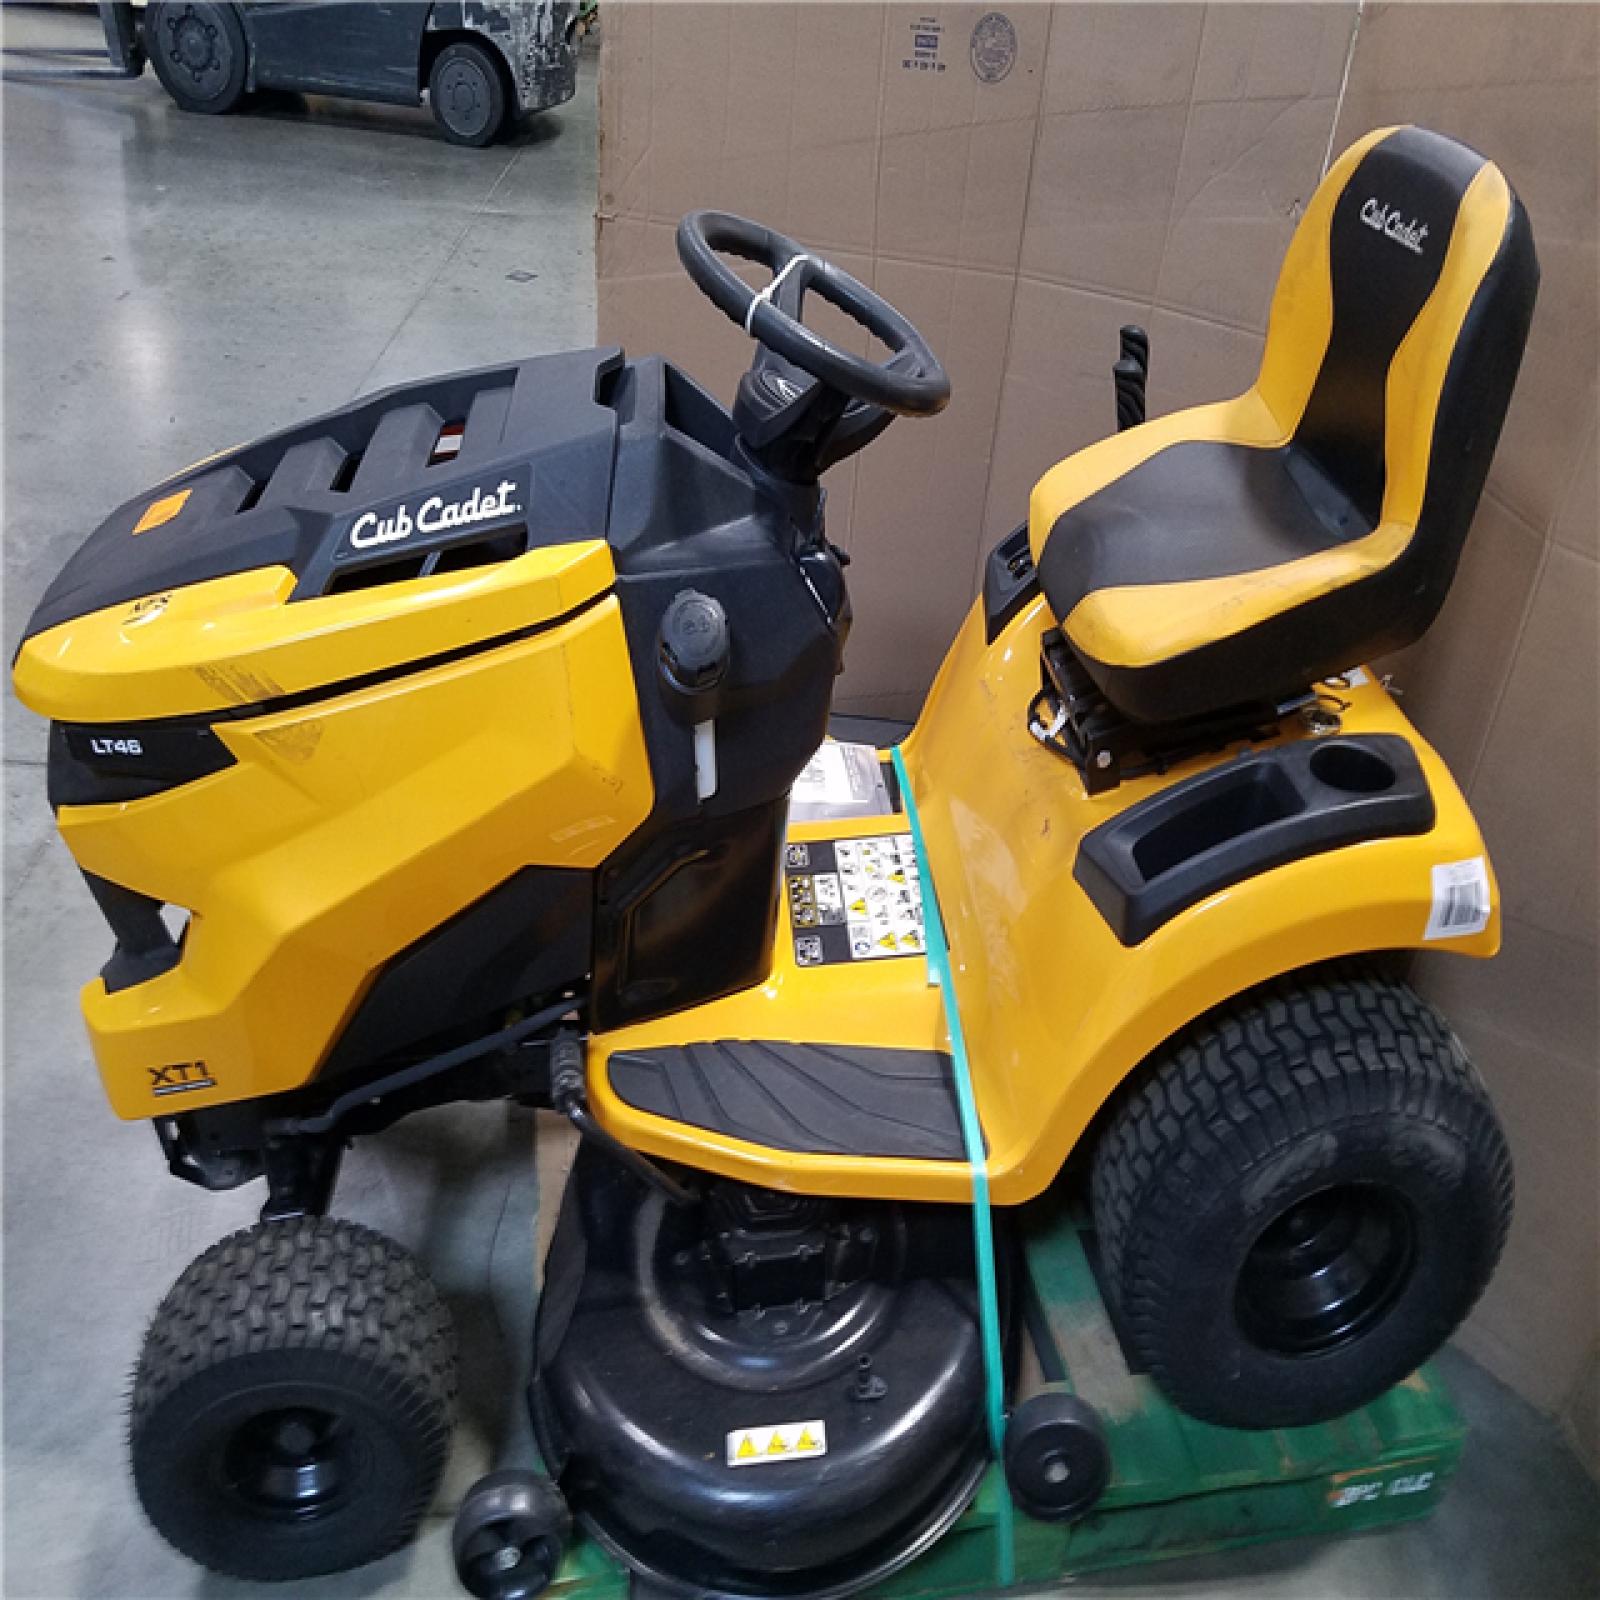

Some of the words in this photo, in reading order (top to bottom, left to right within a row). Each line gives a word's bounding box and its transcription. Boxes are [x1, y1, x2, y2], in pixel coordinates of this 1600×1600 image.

[1360, 197, 1390, 231] Cub
[1384, 209, 1429, 254] Cadet
[350, 505, 413, 549] Cub
[417, 480, 518, 533] Cadet
[90, 738, 143, 756] LT46
[147, 1059, 216, 1086] XT1
